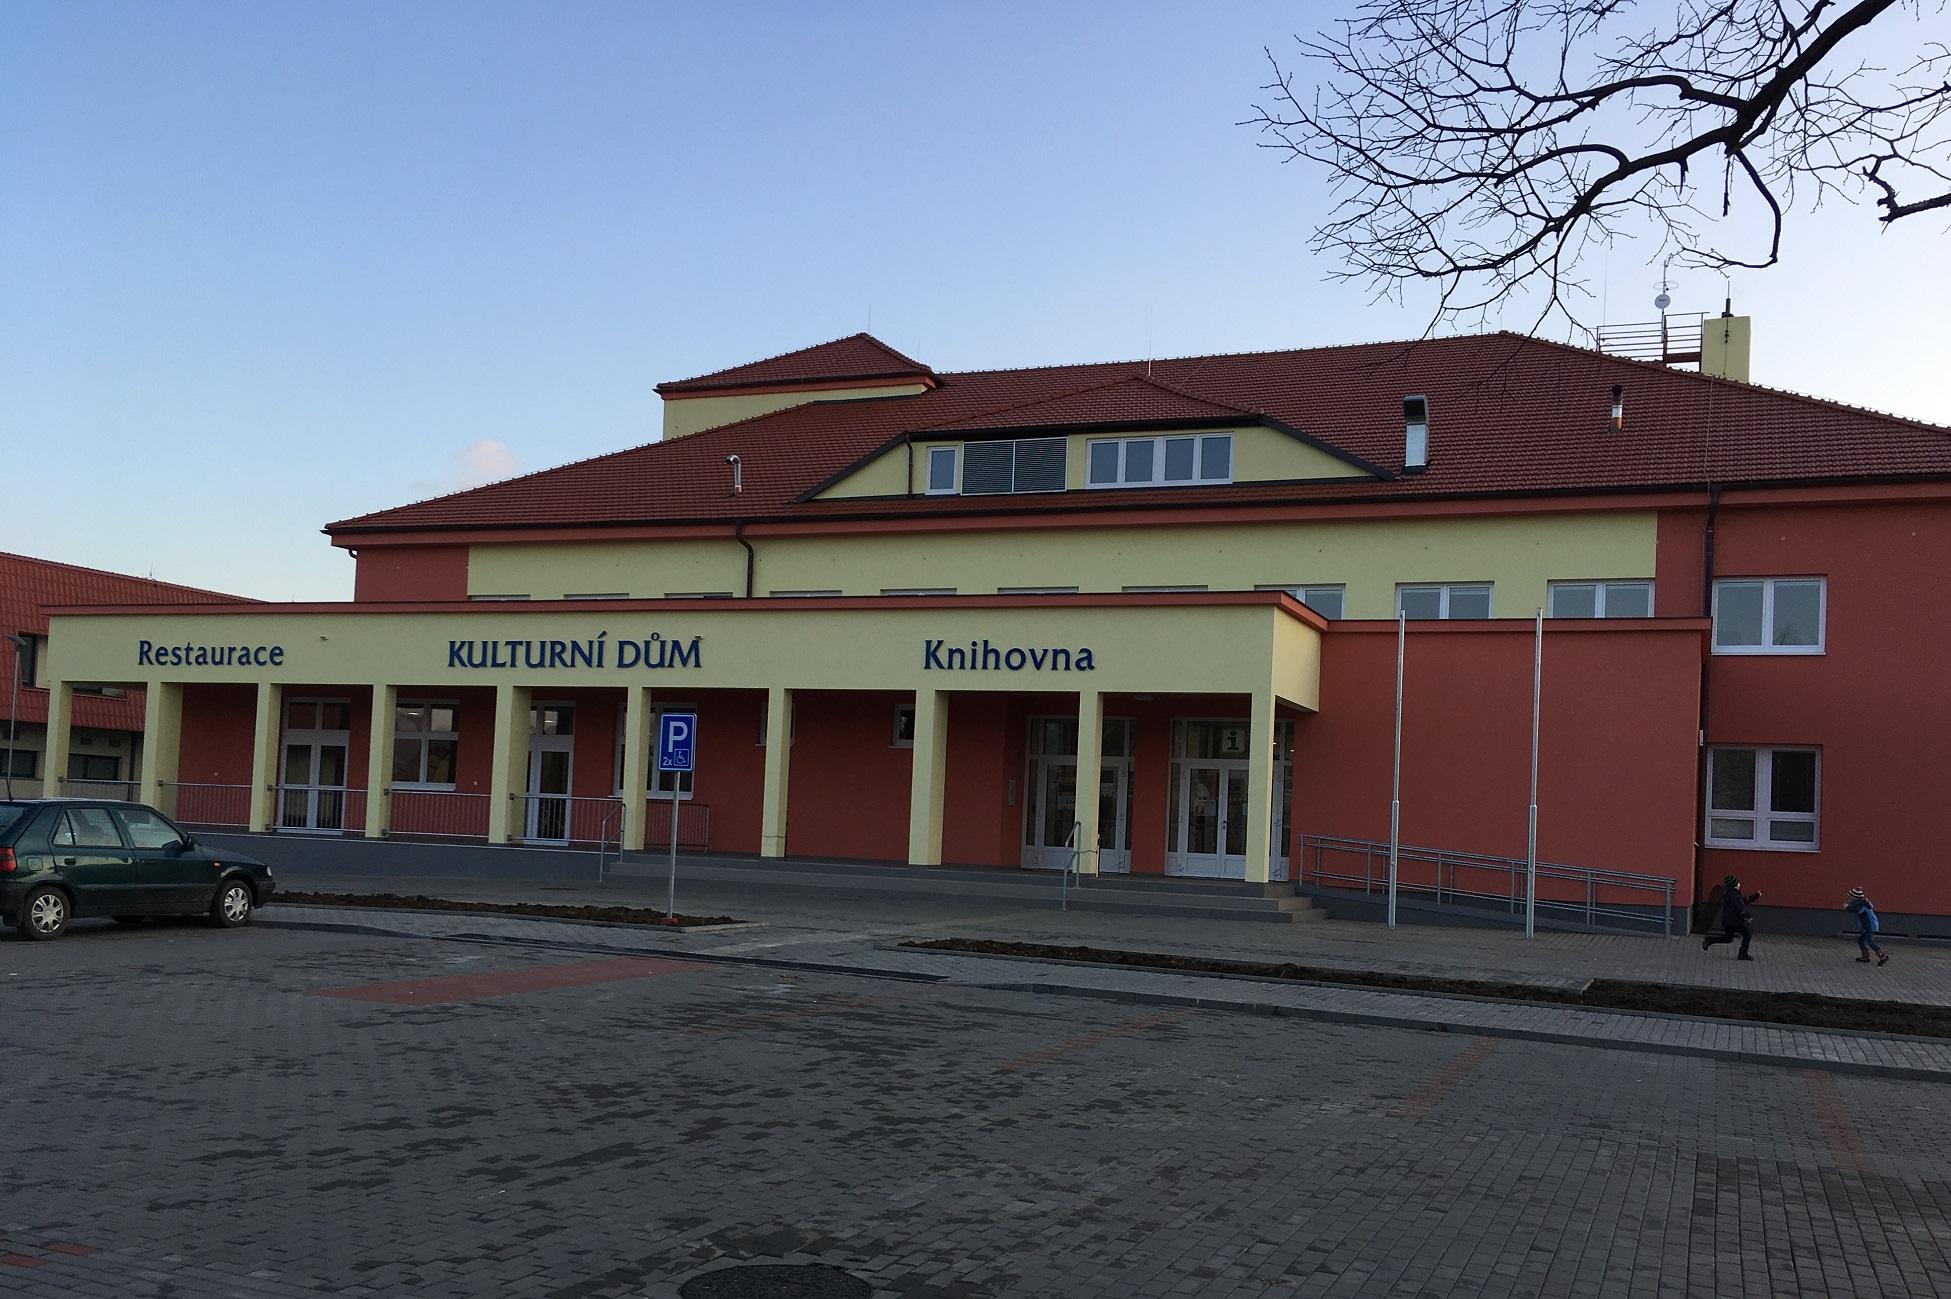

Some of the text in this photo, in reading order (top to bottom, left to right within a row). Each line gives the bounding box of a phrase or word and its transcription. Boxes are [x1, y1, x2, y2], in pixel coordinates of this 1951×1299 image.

[138, 639, 284, 667] Restaurace
[448, 630, 704, 669] KULTURNÍ DŮM
[924, 639, 1096, 671] Knihovna
[668, 721, 689, 753] P
[662, 756, 673, 766] 2x
